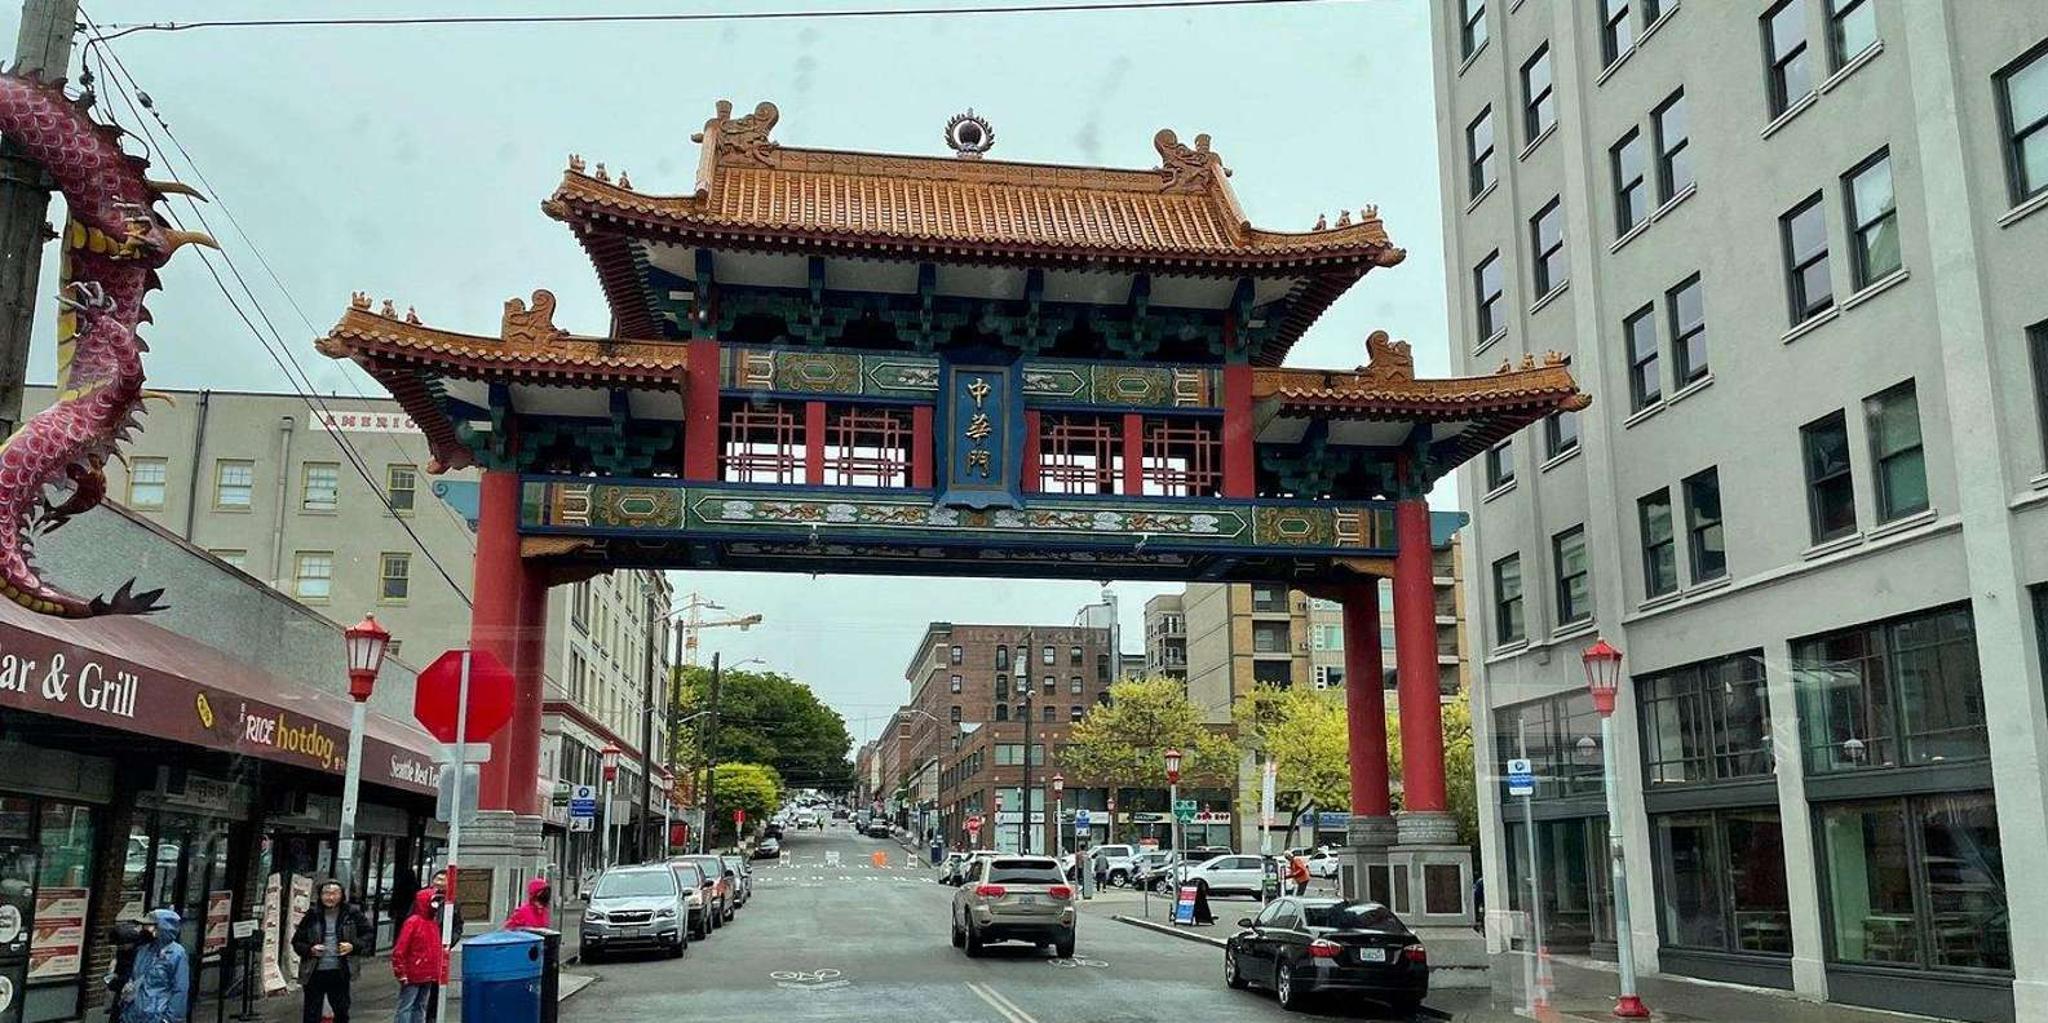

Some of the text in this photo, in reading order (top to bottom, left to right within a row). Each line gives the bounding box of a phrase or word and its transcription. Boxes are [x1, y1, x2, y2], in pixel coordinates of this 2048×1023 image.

[965, 377, 992, 477] 中華門
[0, 653, 139, 718] ar & Grill
[245, 713, 335, 768] RICE hotdog
[414, 762, 429, 786] Best
